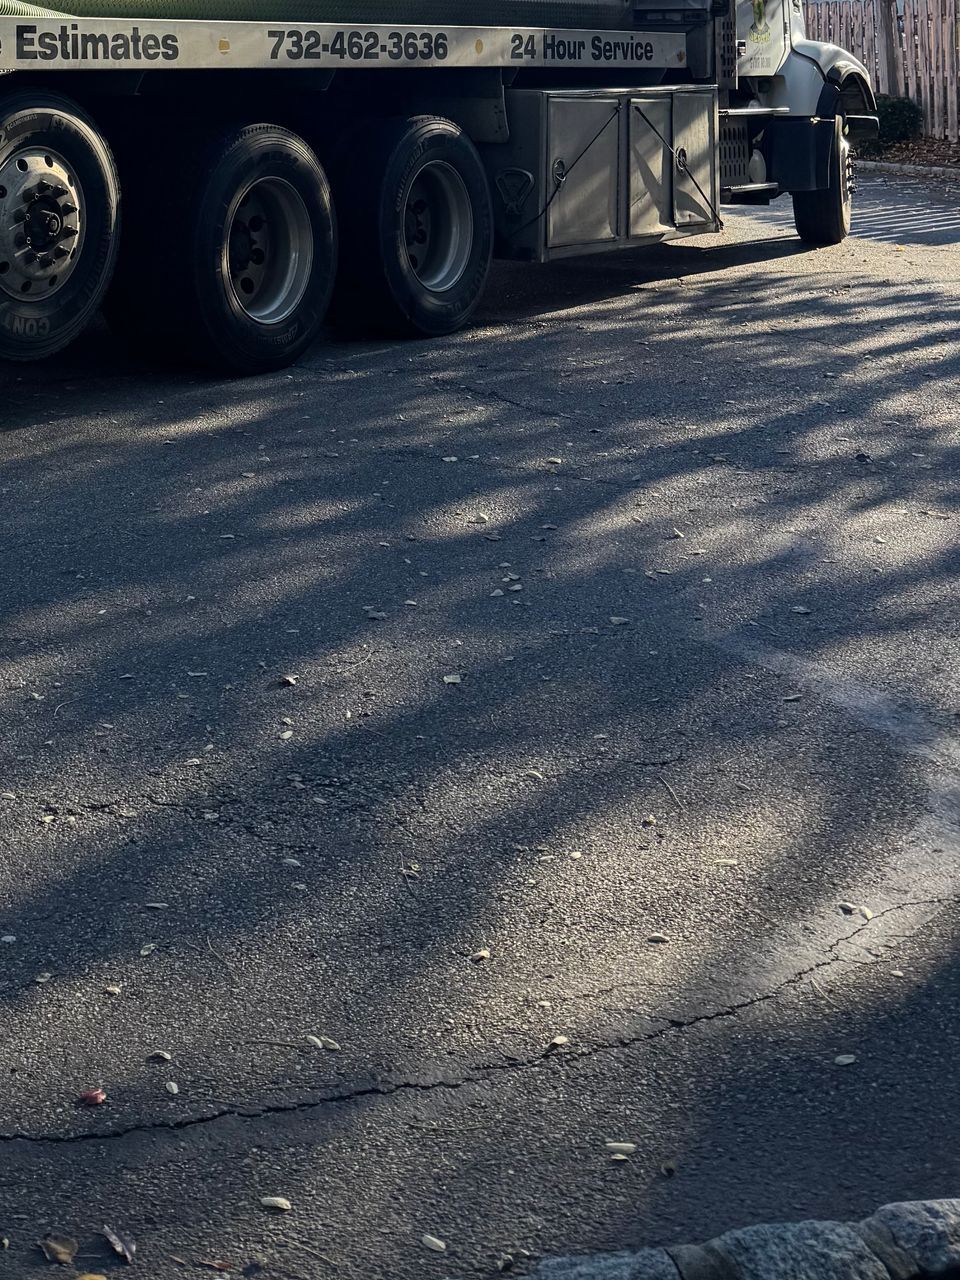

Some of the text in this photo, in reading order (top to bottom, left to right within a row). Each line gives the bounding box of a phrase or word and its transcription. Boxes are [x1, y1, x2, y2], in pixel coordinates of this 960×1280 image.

[16, 23, 179, 61] Estimates
[267, 29, 653, 62] 732-462-3636 24 Hour Service
